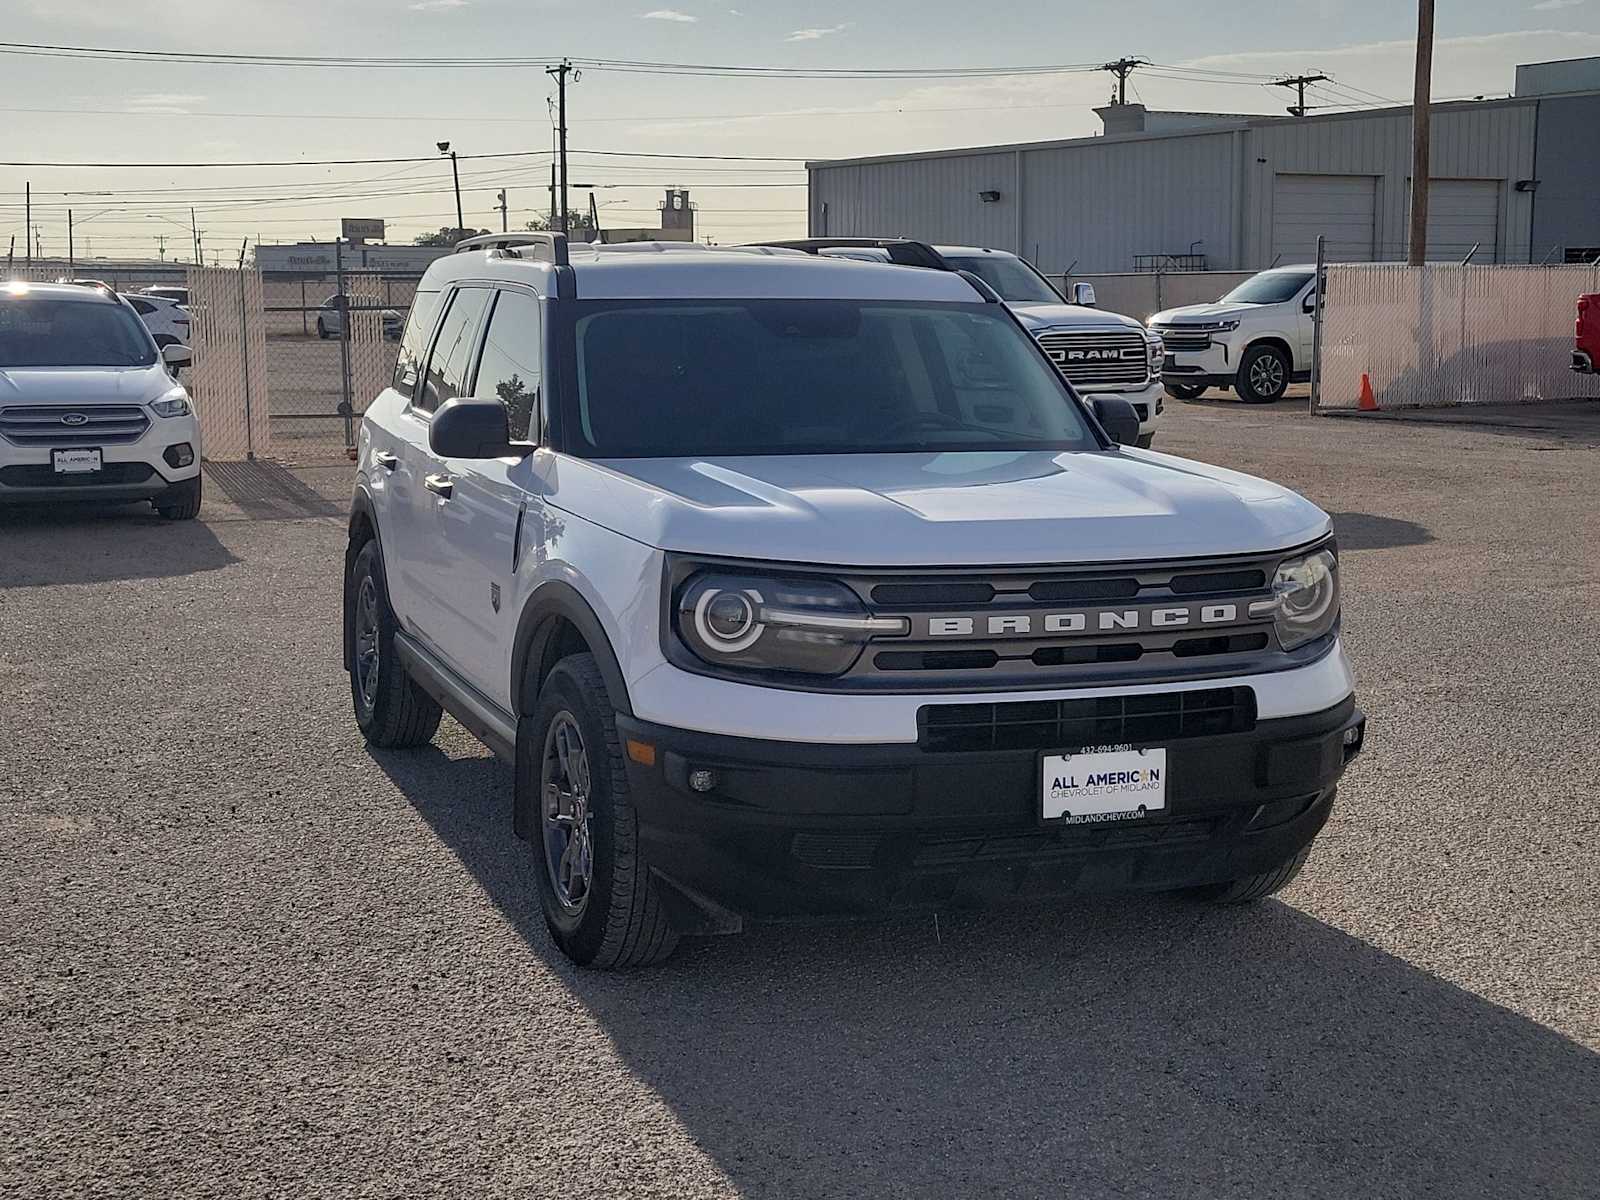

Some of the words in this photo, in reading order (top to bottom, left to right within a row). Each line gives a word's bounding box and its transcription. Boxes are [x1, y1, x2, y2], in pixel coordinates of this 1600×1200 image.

[1068, 350, 1118, 360] RAM
[929, 604, 1237, 636] BRONCO
[1050, 786, 1105, 799] CHEVROLET
[1106, 785, 1119, 795] OF
[1120, 780, 1160, 794] MIDLAND
[1052, 775, 1079, 790] ALL
[1065, 809, 1145, 825] MIDLANDCHEVY.COM
